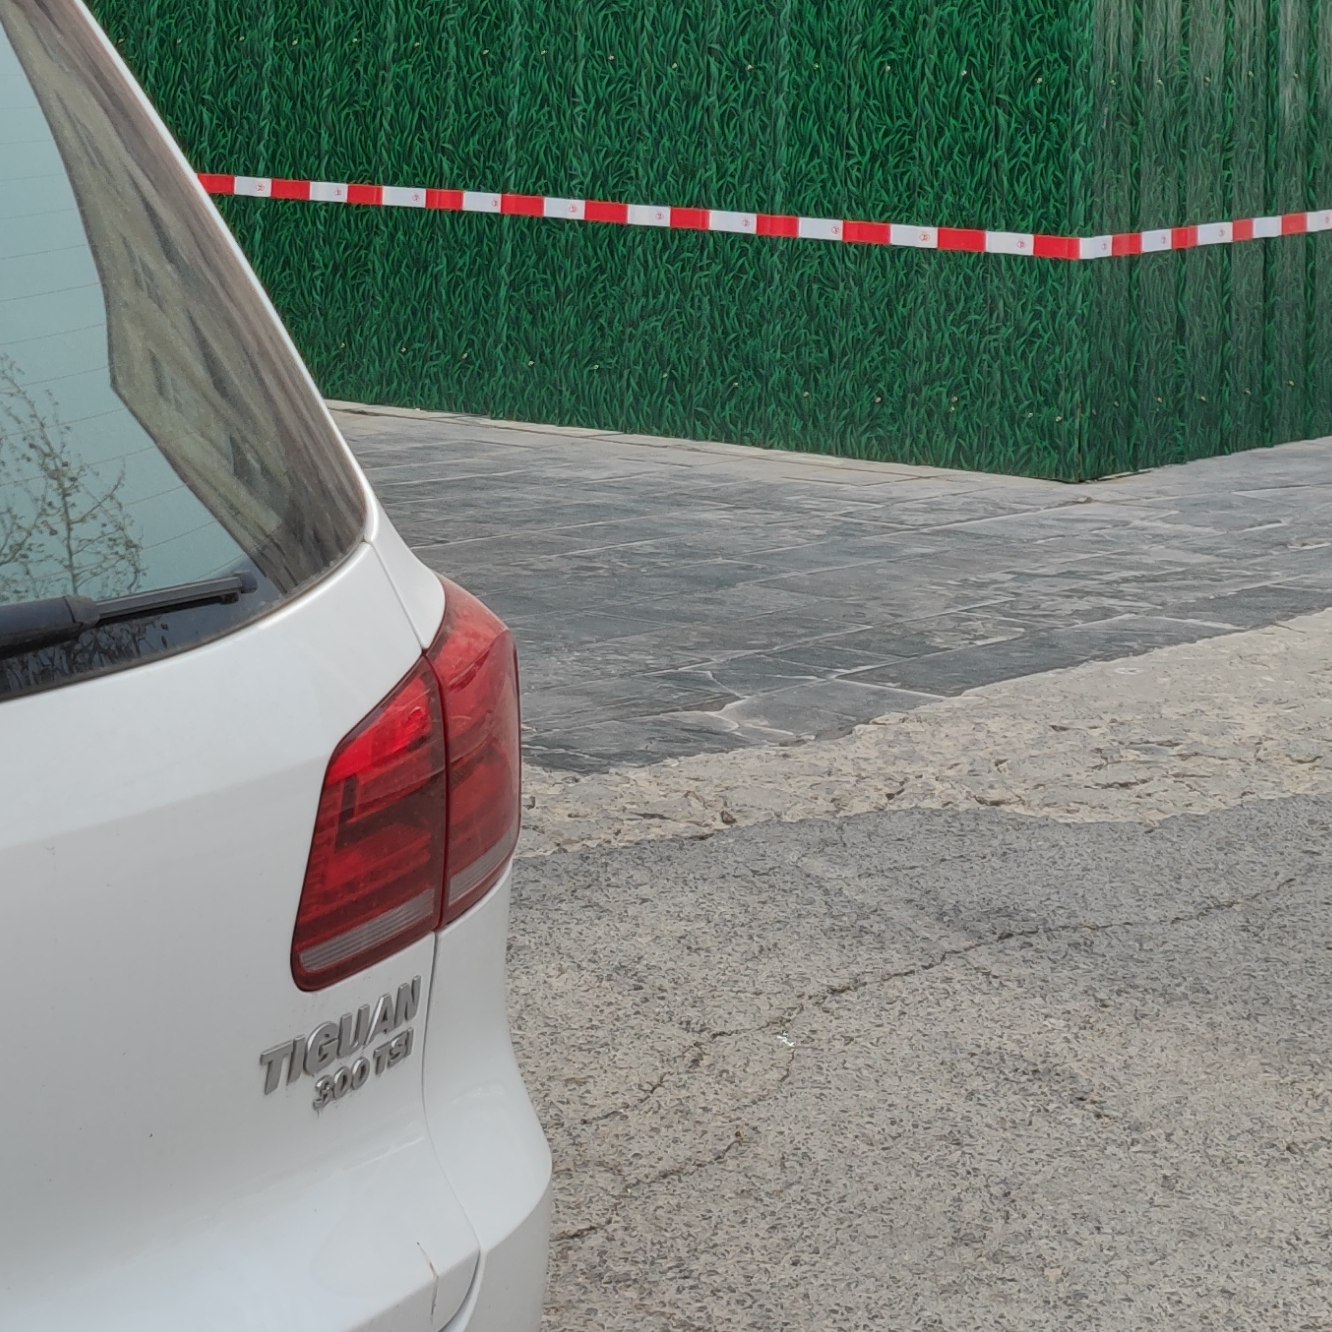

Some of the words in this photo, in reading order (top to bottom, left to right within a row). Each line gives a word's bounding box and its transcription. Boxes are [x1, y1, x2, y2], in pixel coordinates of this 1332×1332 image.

[260, 974, 421, 1095] TIGUAN
[313, 1056, 370, 1110] 300
[373, 1027, 414, 1076] TSI
